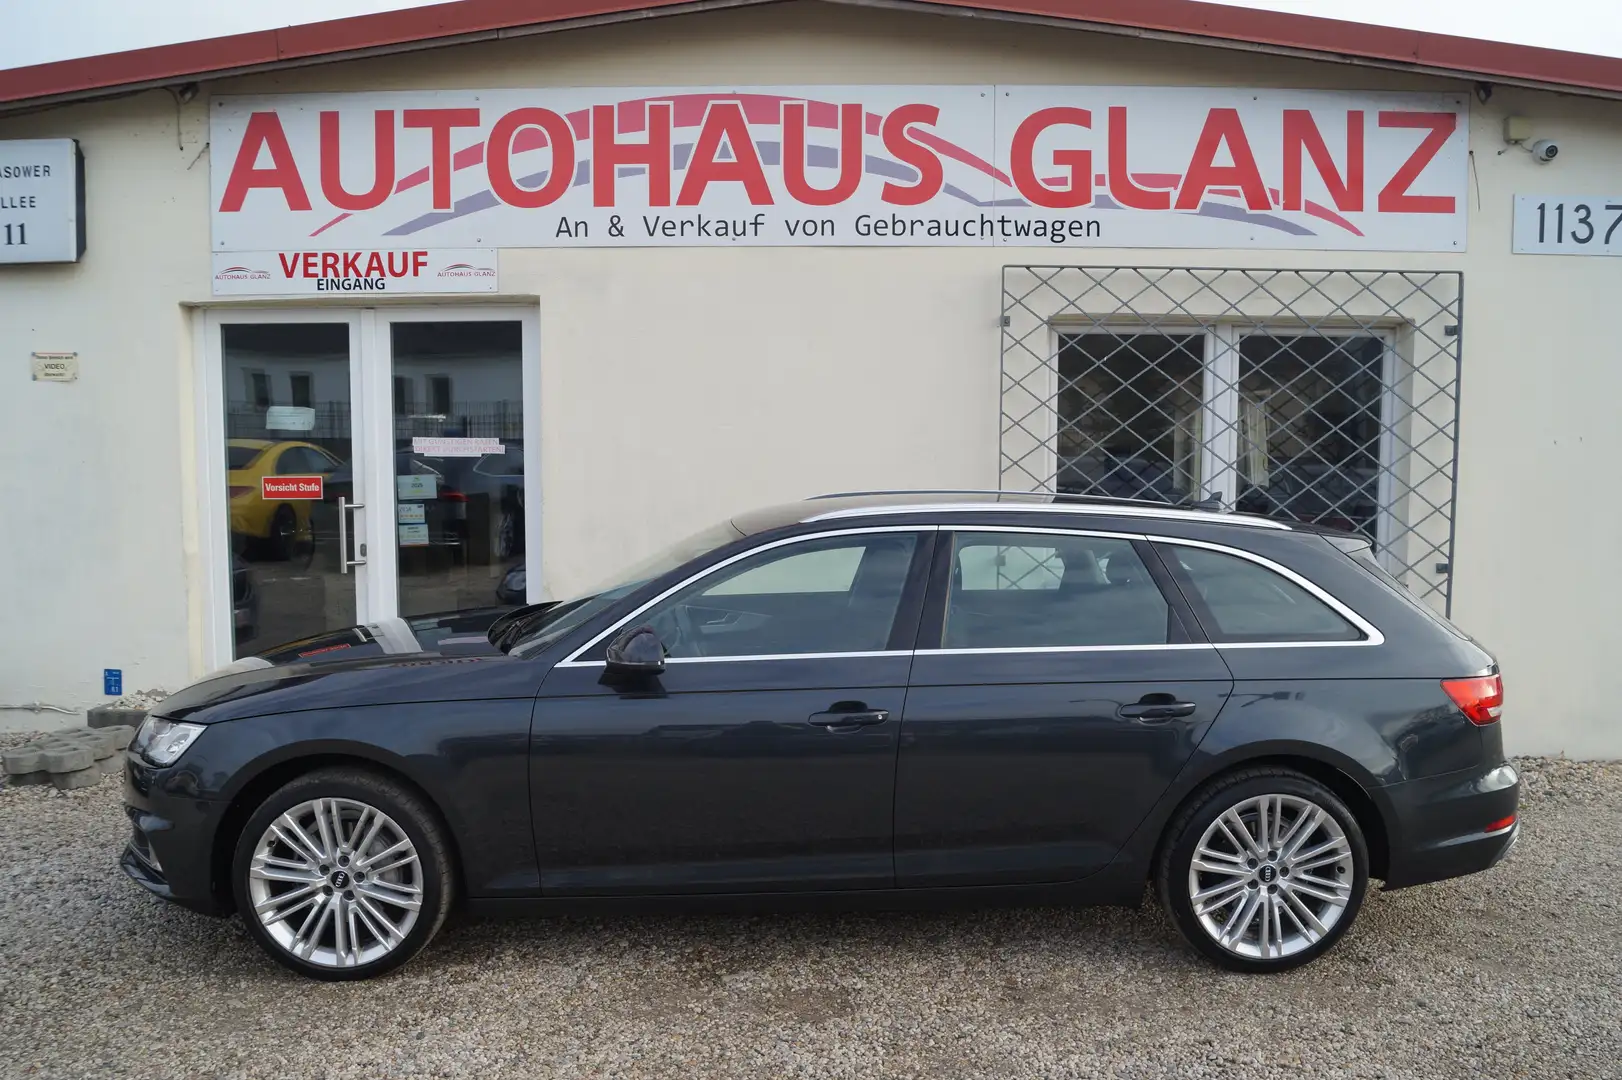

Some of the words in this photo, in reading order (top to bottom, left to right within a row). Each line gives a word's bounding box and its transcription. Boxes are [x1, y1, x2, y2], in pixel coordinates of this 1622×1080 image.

[219, 102, 943, 212] AUTOHAUS
[1010, 106, 1456, 213] GLANZ
[4, 222, 28, 246] 11
[556, 216, 589, 238] An
[608, 216, 625, 238] &
[643, 213, 766, 238] Verkauf
[785, 219, 835, 237] von
[855, 214, 1101, 242] Gebrauchtwagen
[278, 251, 428, 278] VERKAUF
[317, 278, 386, 291] EINGANG
[265, 483, 297, 492] Vorsicht
[299, 483, 320, 492] Stufe
